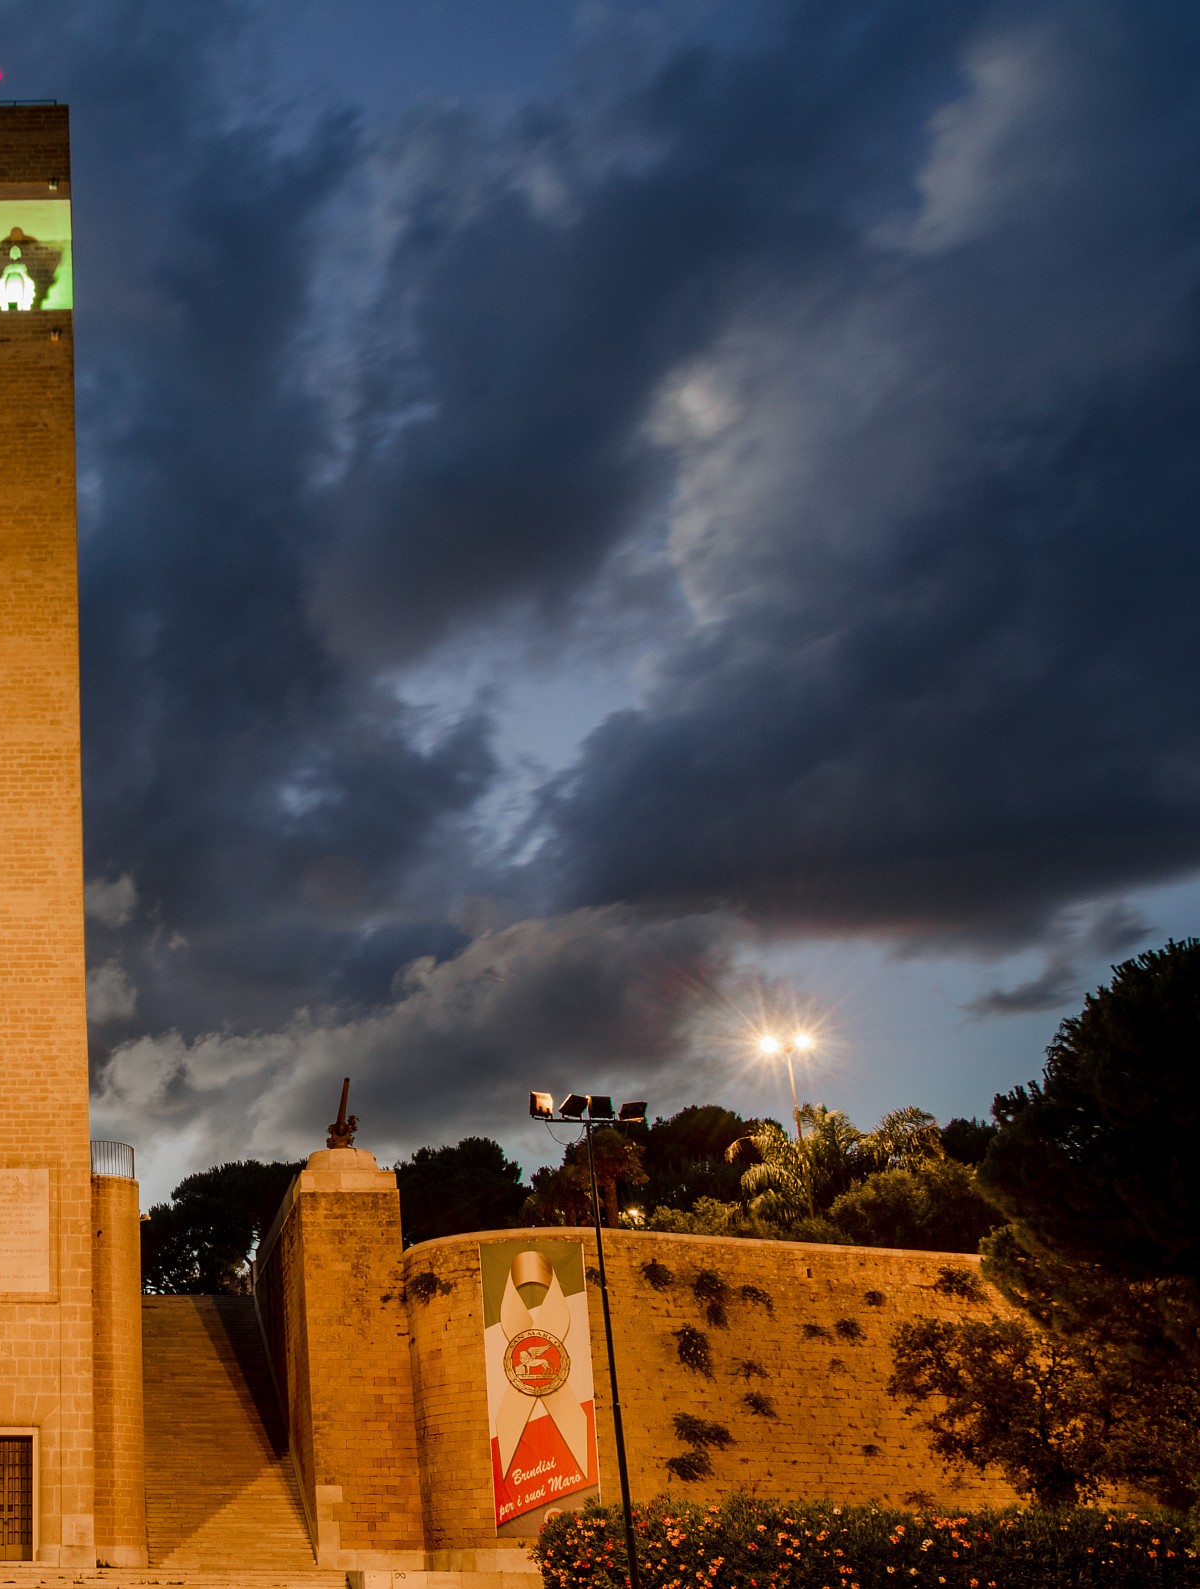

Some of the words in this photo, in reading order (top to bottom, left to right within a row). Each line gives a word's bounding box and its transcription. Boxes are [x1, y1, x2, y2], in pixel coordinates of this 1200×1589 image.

[510, 1334, 525, 1349] SAN
[527, 1331, 561, 1348] MARCO
[511, 1456, 557, 1485] Brindisi
[499, 1501, 515, 1521] per
[516, 1494, 523, 1507] i
[525, 1485, 547, 1504] suoi
[548, 1470, 583, 1492] Marò
